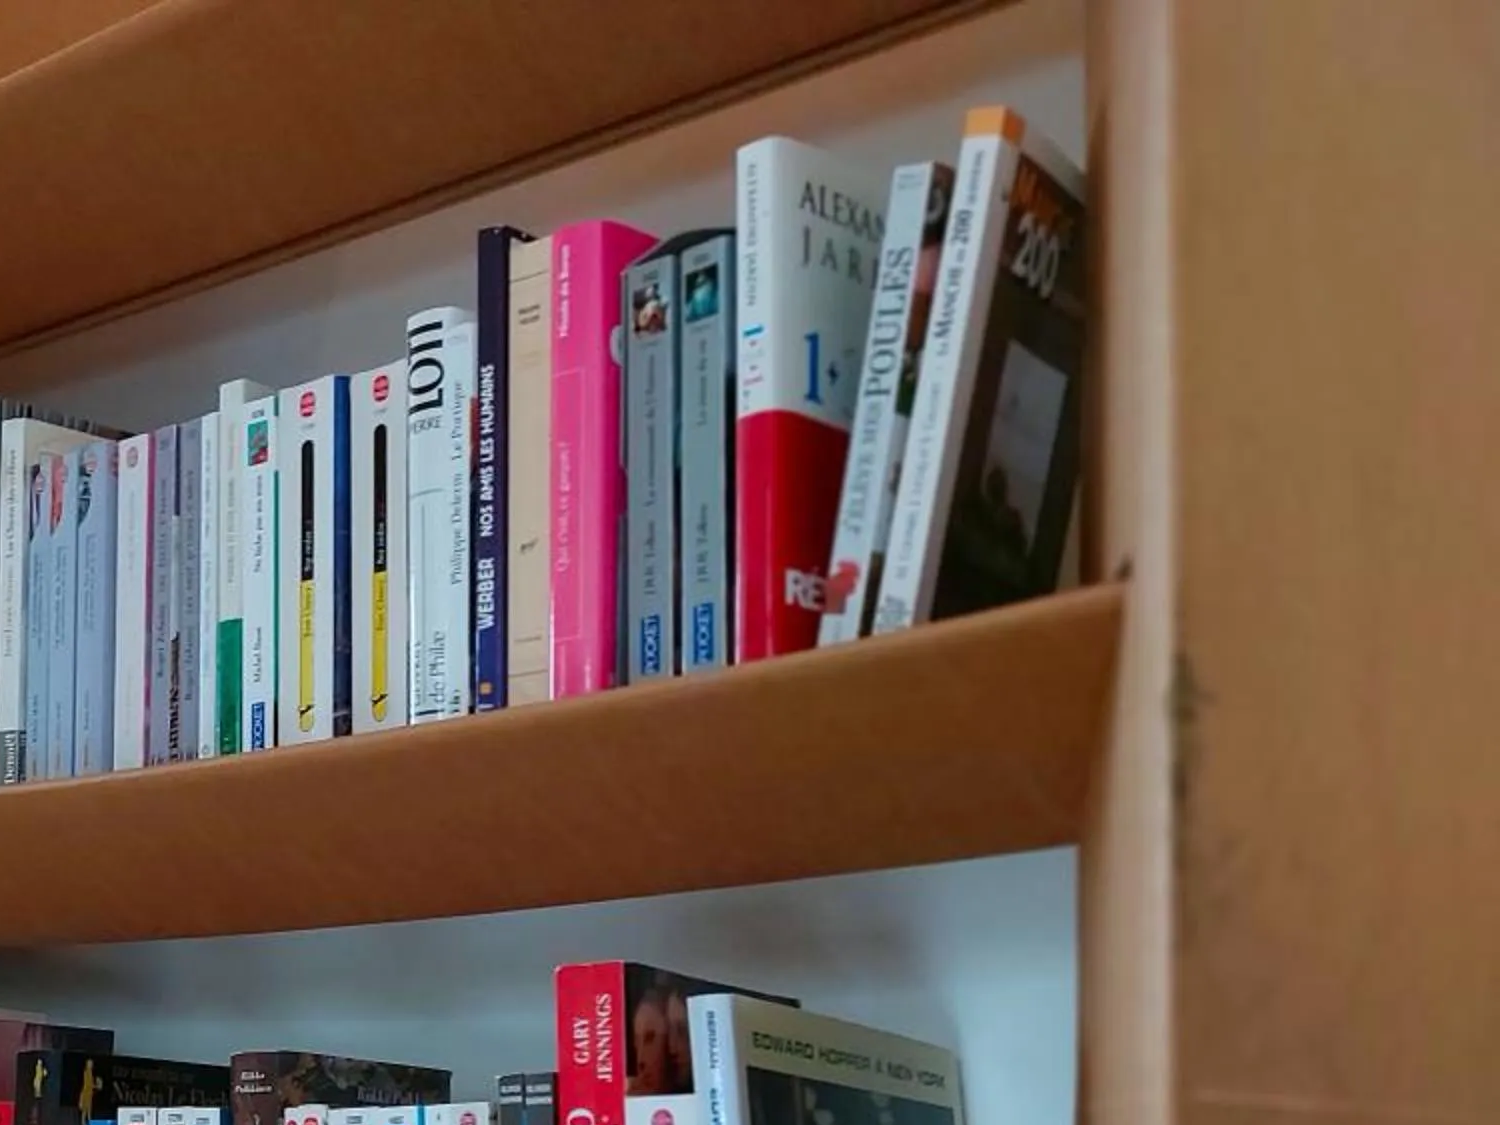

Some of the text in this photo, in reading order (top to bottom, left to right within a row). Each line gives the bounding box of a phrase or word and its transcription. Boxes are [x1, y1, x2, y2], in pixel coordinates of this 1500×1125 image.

[798, 180, 886, 243] ALEXAN
[951, 209, 974, 246] 200
[801, 227, 879, 291] JAR
[1009, 219, 1059, 300] 200
[863, 246, 914, 399] POULES
[407, 321, 444, 416] LOTI
[803, 332, 823, 406] 1
[451, 444, 462, 461] Le
[479, 365, 495, 630] WERBER NOS AMIS LES HUMAINS
[451, 529, 466, 585] Philippe
[642, 616, 658, 674] POCKET
[695, 603, 710, 664] POCKET
[429, 681, 445, 704] de
[573, 1018, 591, 1064] GARY
[595, 993, 613, 1082] JENNINGS
[752, 1031, 816, 1062] EDWARD
[818, 1042, 872, 1073] HOPPER
[886, 1060, 915, 1083] NEW
[916, 1065, 947, 1089] YORK
